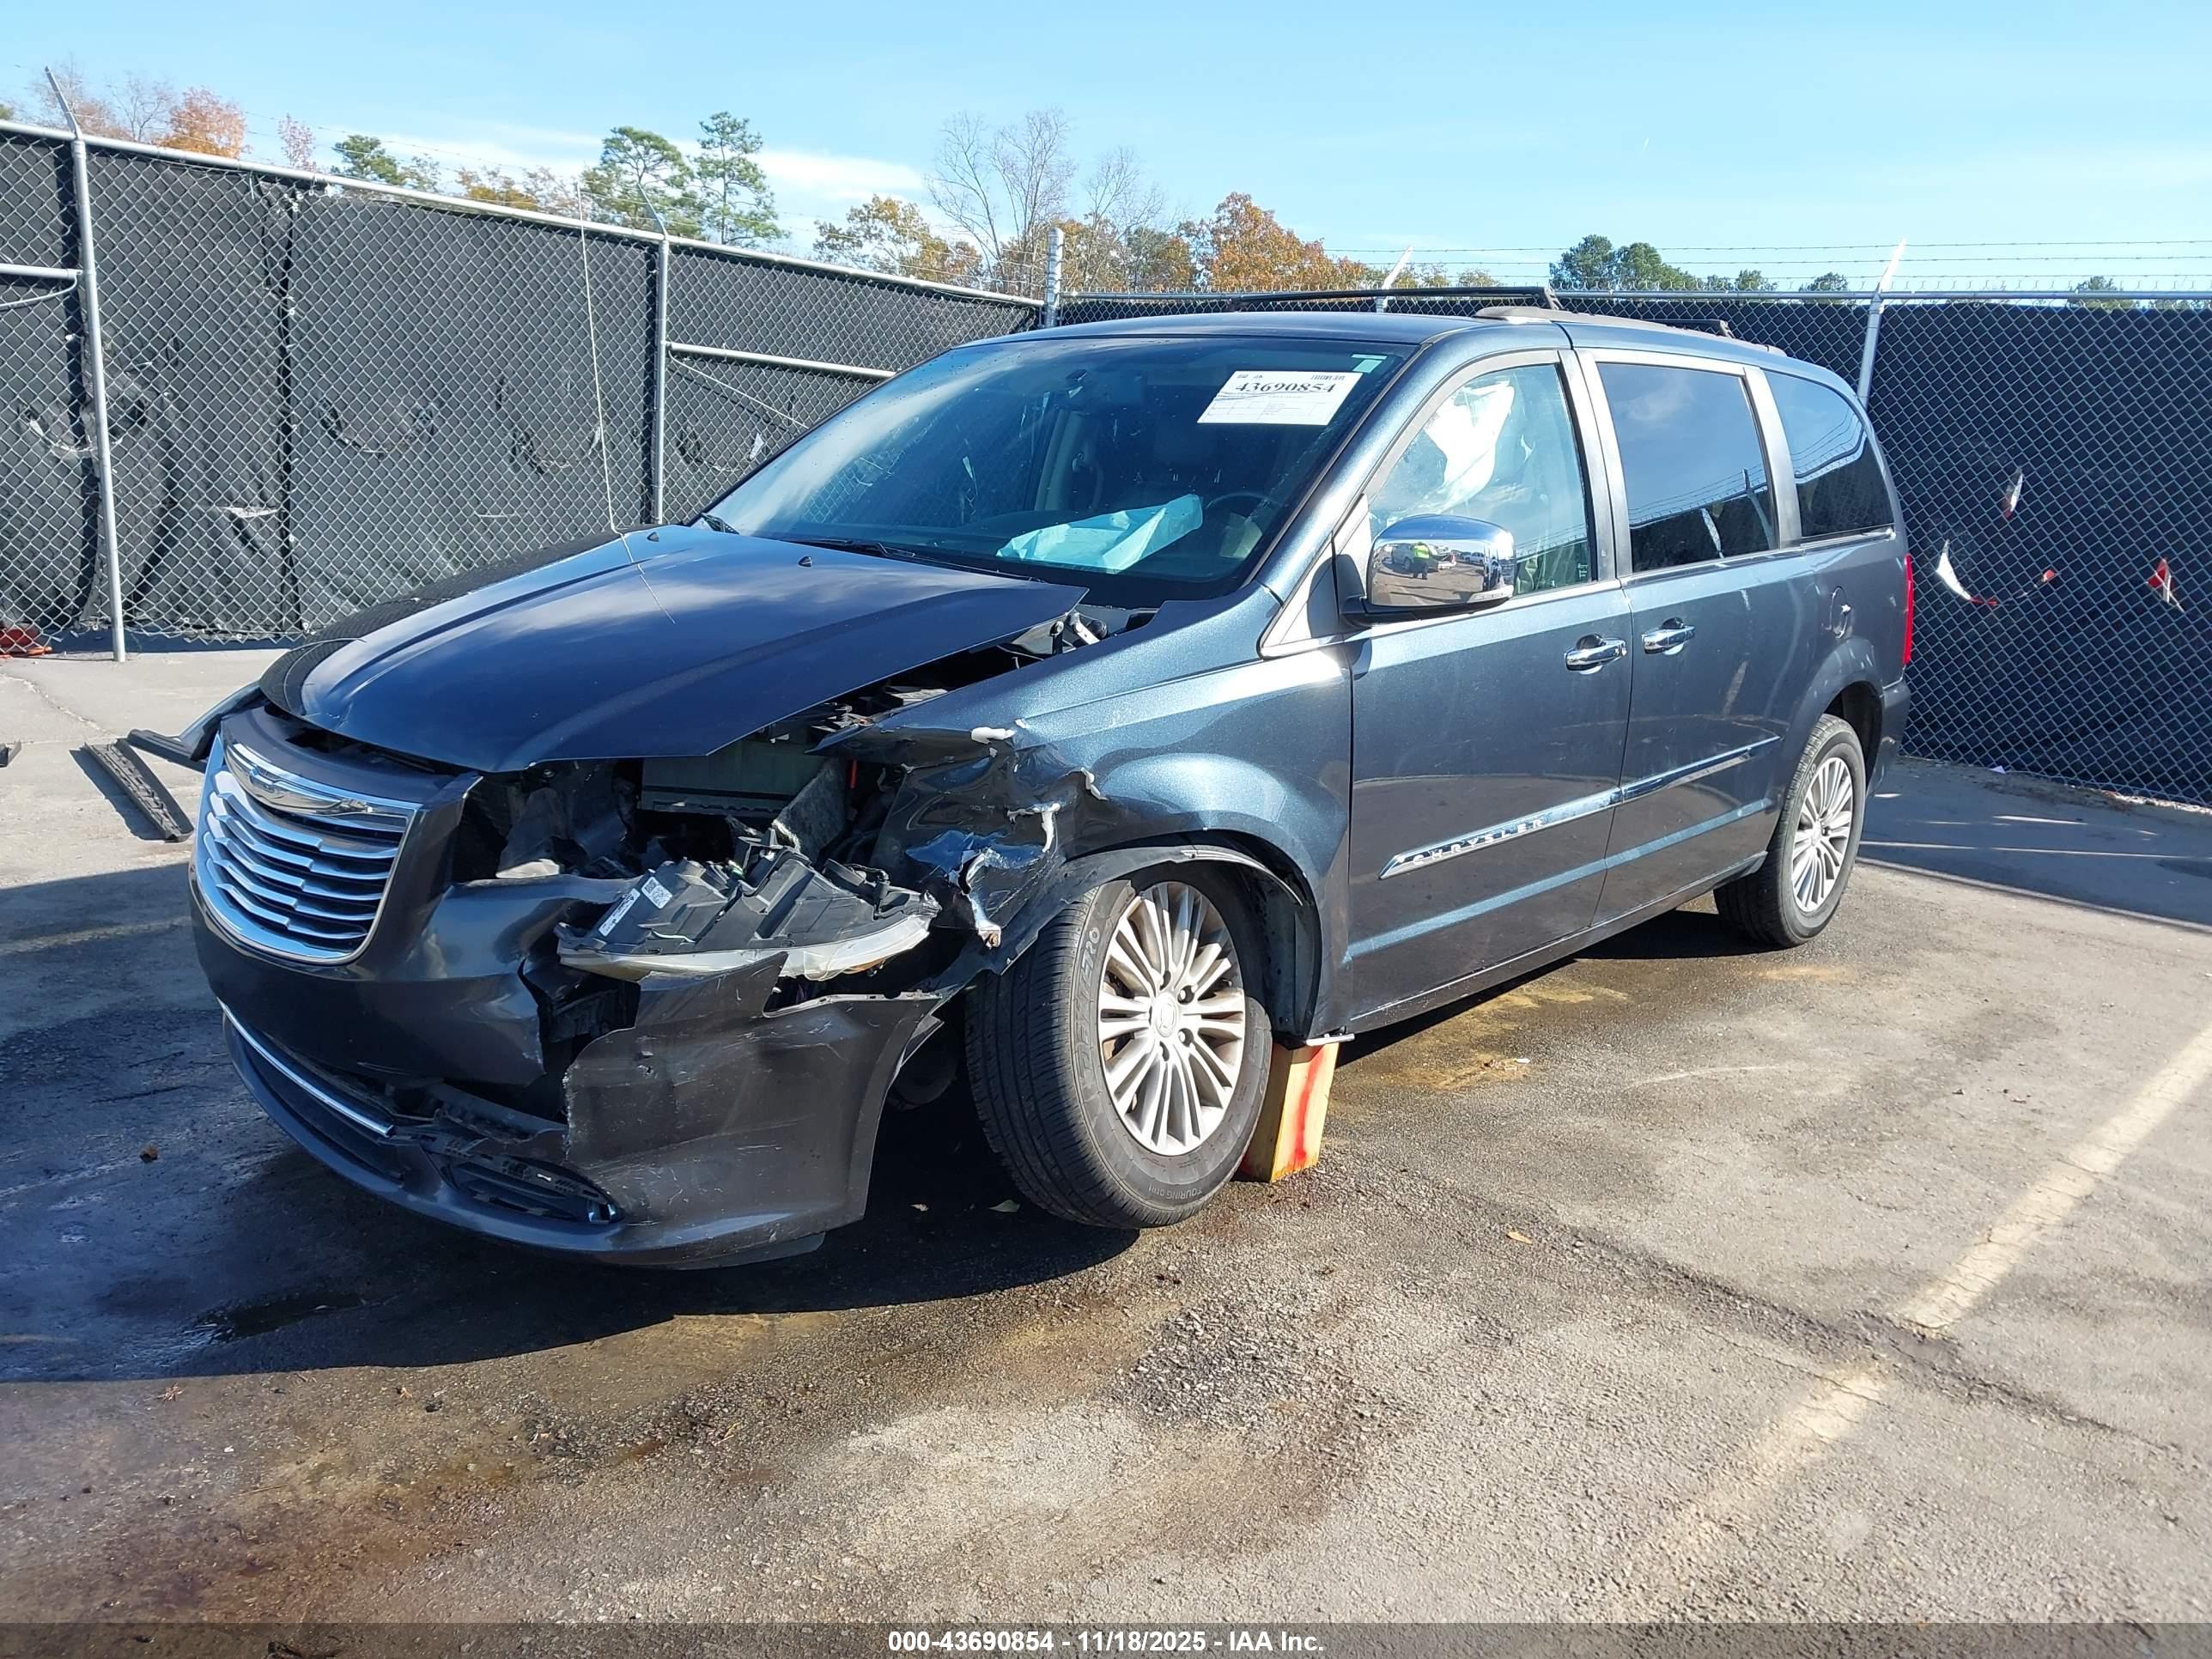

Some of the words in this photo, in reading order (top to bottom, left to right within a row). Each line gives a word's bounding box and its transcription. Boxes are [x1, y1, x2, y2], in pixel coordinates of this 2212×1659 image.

[1235, 382, 1337, 392] 43690854
[1413, 819, 1543, 866] CHRYSLER
[1166, 1188, 1202, 1200] TOURING
